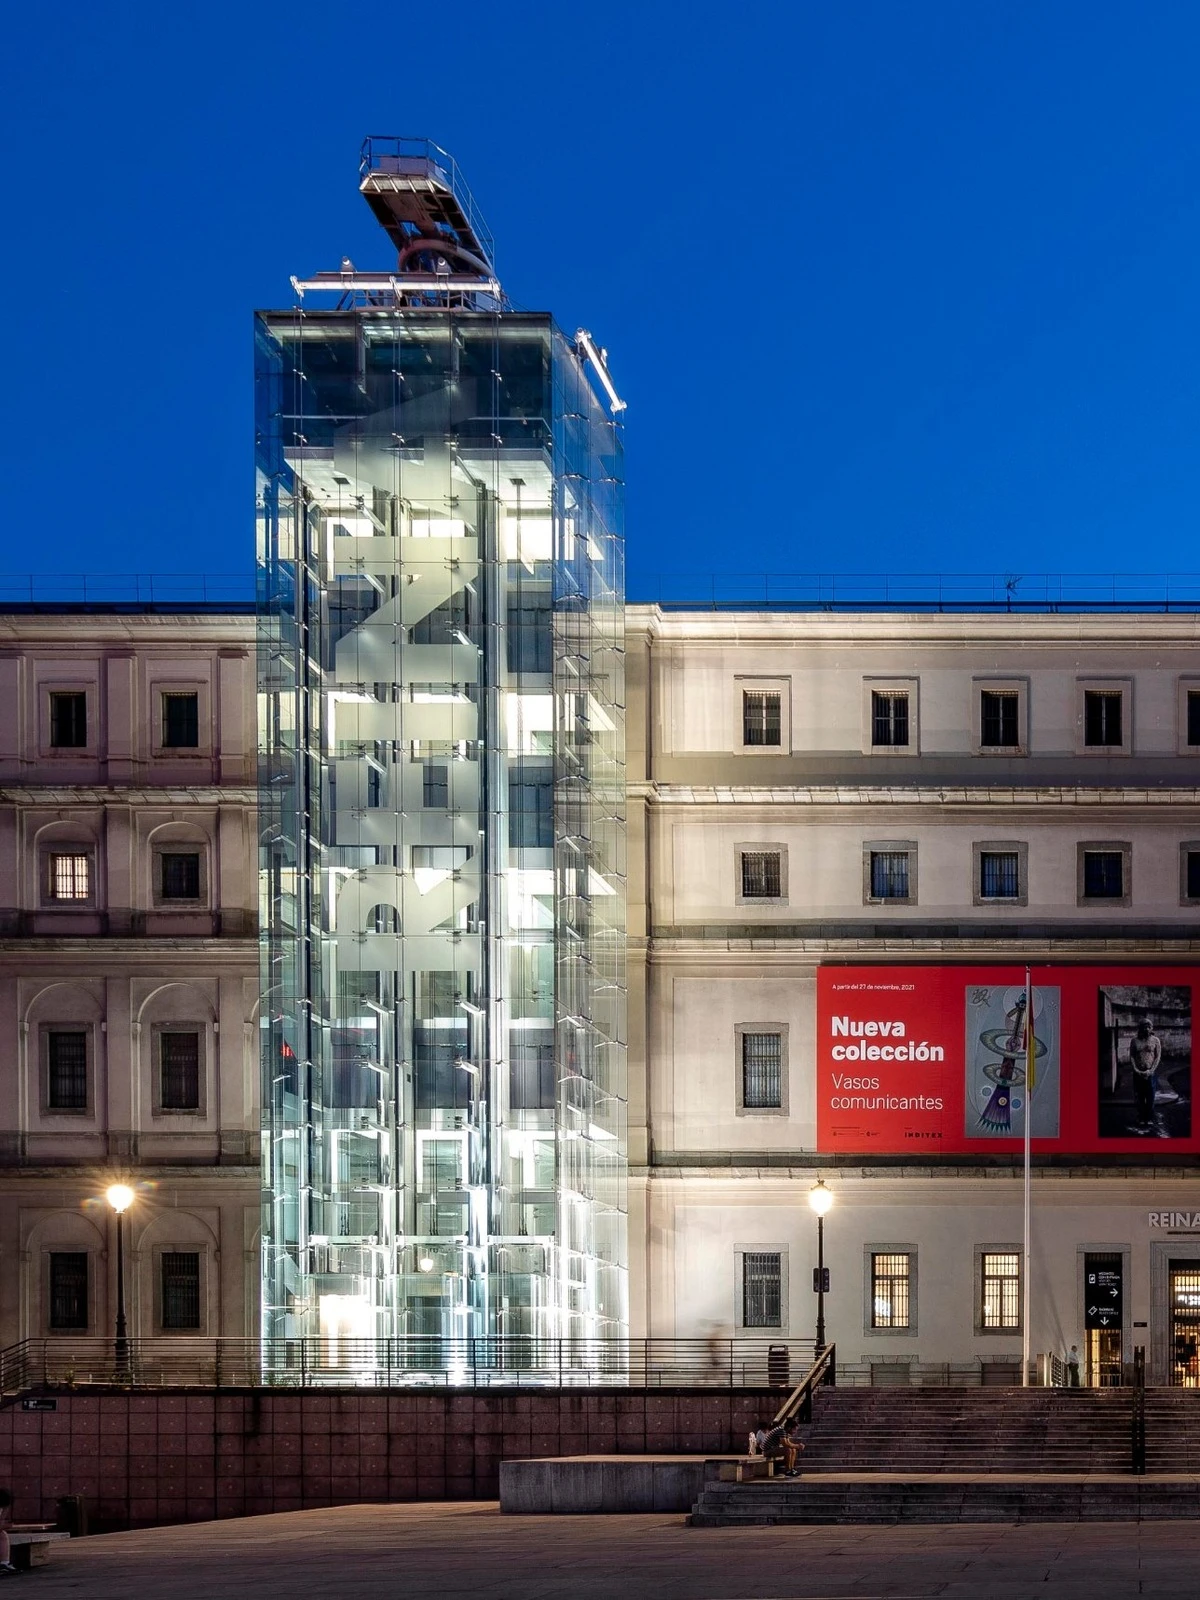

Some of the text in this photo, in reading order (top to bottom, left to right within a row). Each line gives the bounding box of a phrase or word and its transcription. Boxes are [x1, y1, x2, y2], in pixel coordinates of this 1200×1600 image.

[334, 376, 480, 971] REINA
[832, 1016, 905, 1037] Nueva
[831, 1040, 944, 1062] colección
[832, 1073, 879, 1090] Vasos
[831, 1094, 943, 1110] comunicantes
